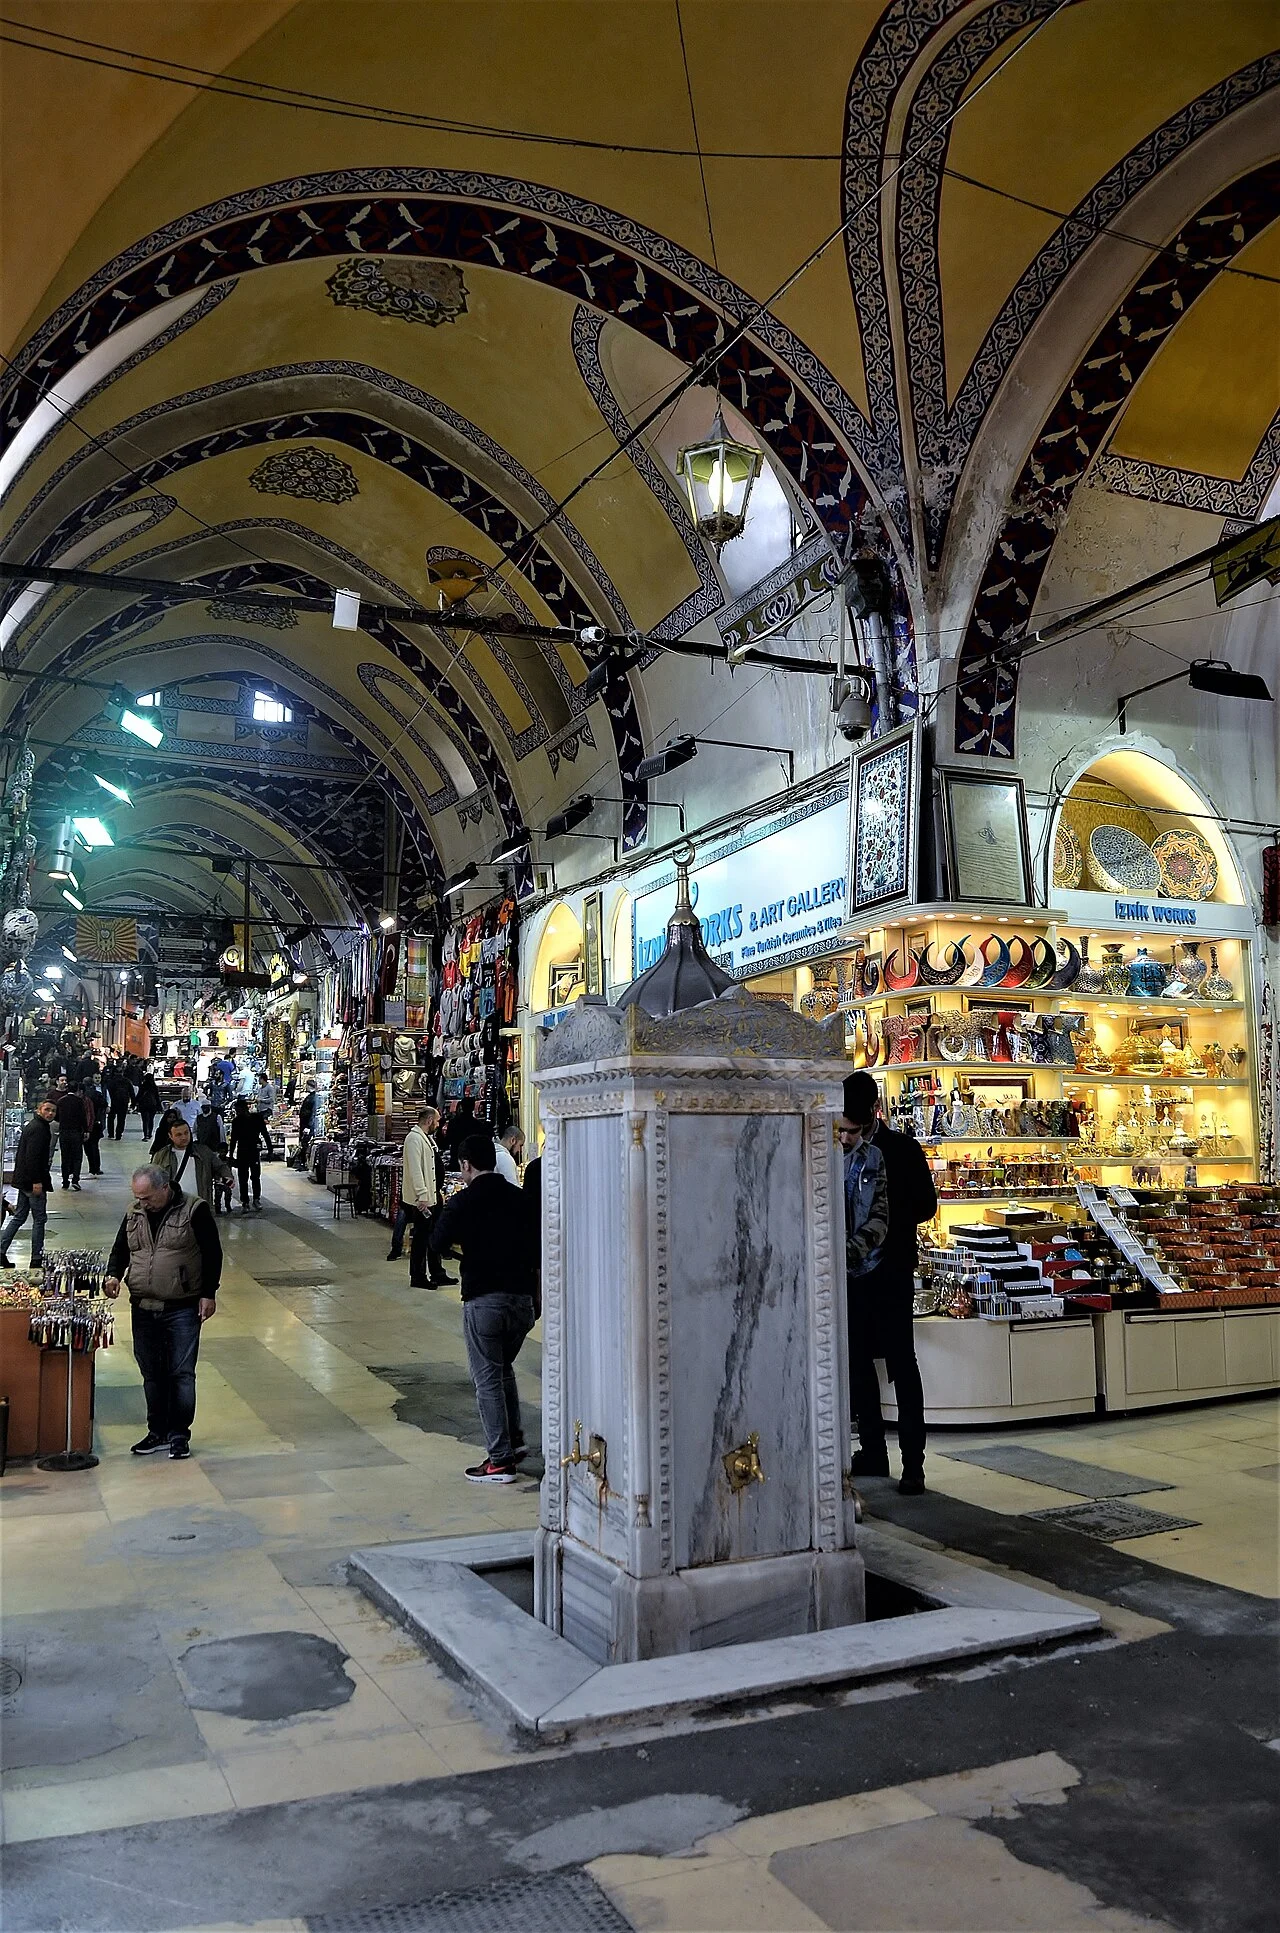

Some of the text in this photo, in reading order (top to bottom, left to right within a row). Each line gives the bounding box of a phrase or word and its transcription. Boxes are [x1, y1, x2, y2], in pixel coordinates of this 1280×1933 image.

[638, 877, 846, 973] İZNİ ORKS & ART GALLERY
[1115, 899, 1197, 926] İZNİK WORKS
[756, 934, 782, 954] Turkish
[782, 925, 817, 945] Ceramics
[816, 920, 825, 935] &
[824, 916, 843, 931] Tiles
